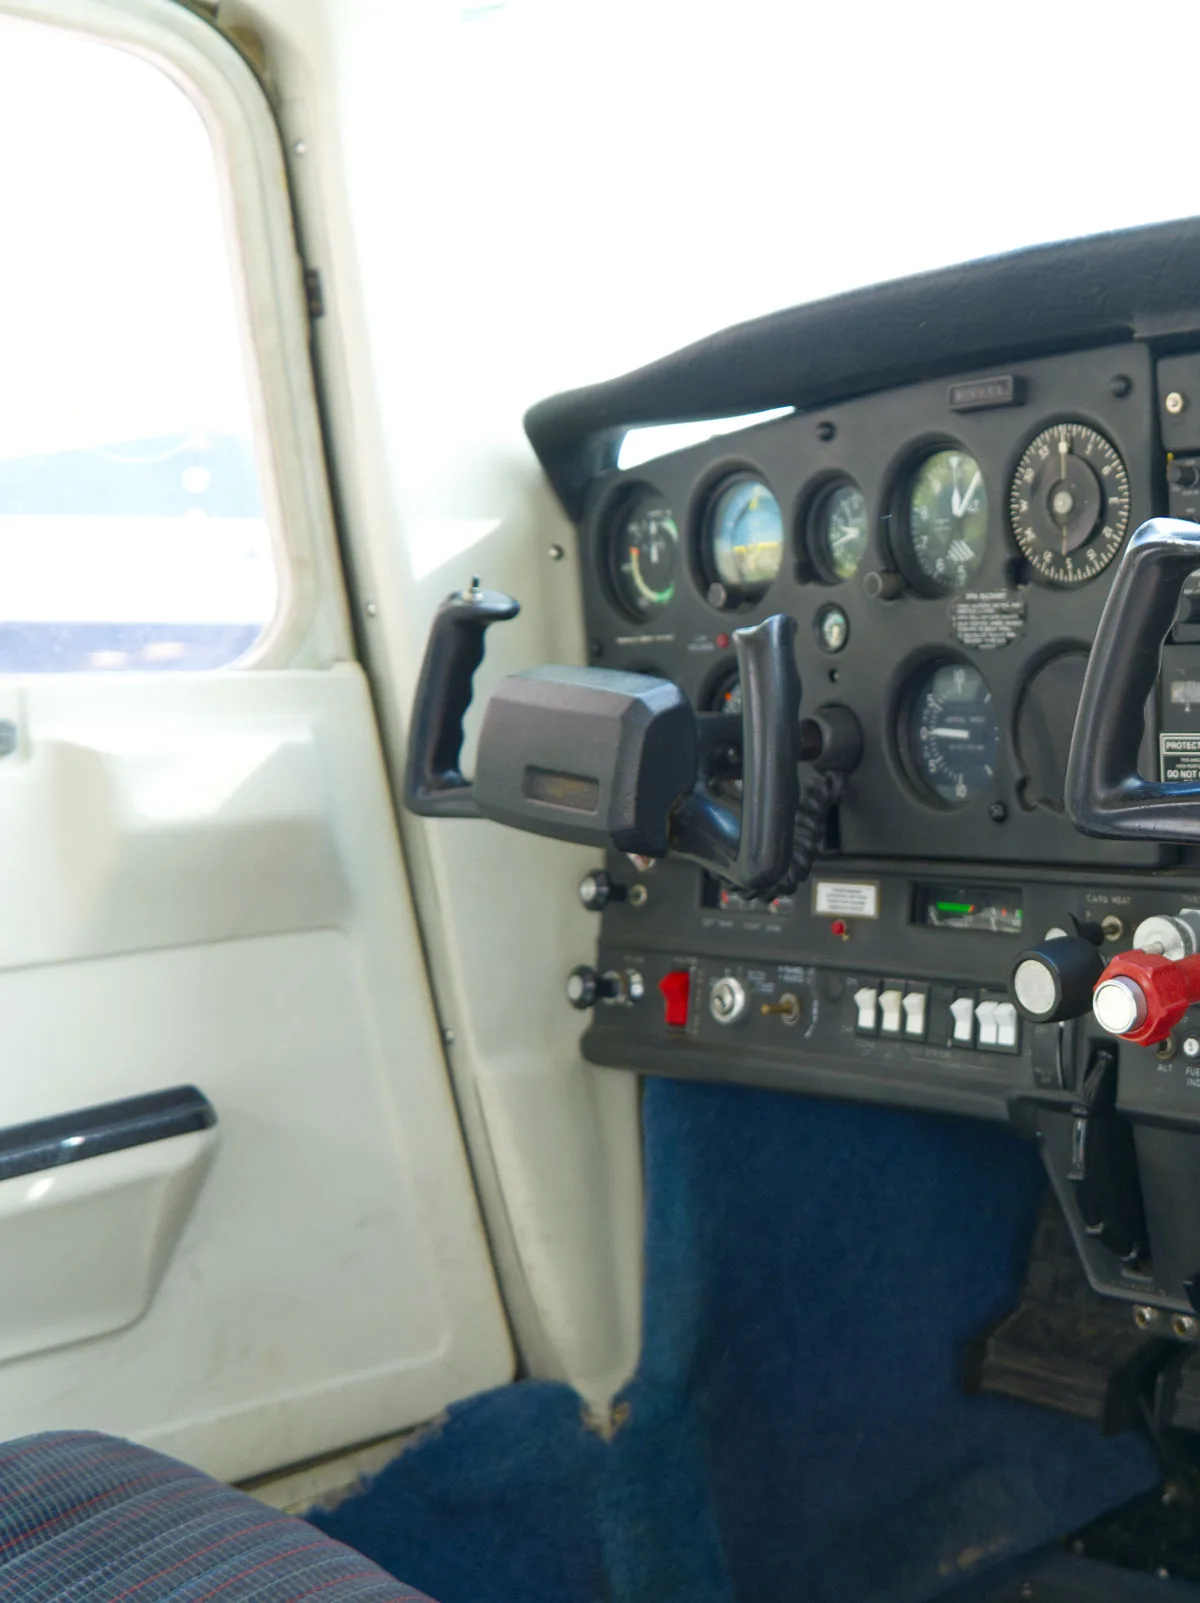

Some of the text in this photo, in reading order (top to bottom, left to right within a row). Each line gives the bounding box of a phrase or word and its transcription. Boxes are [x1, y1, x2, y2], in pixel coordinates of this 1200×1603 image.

[1166, 741, 1200, 750] PROTECT
[1167, 770, 1179, 778] DO
[1181, 770, 1198, 778] NOT
[1157, 1064, 1172, 1072] ALT
